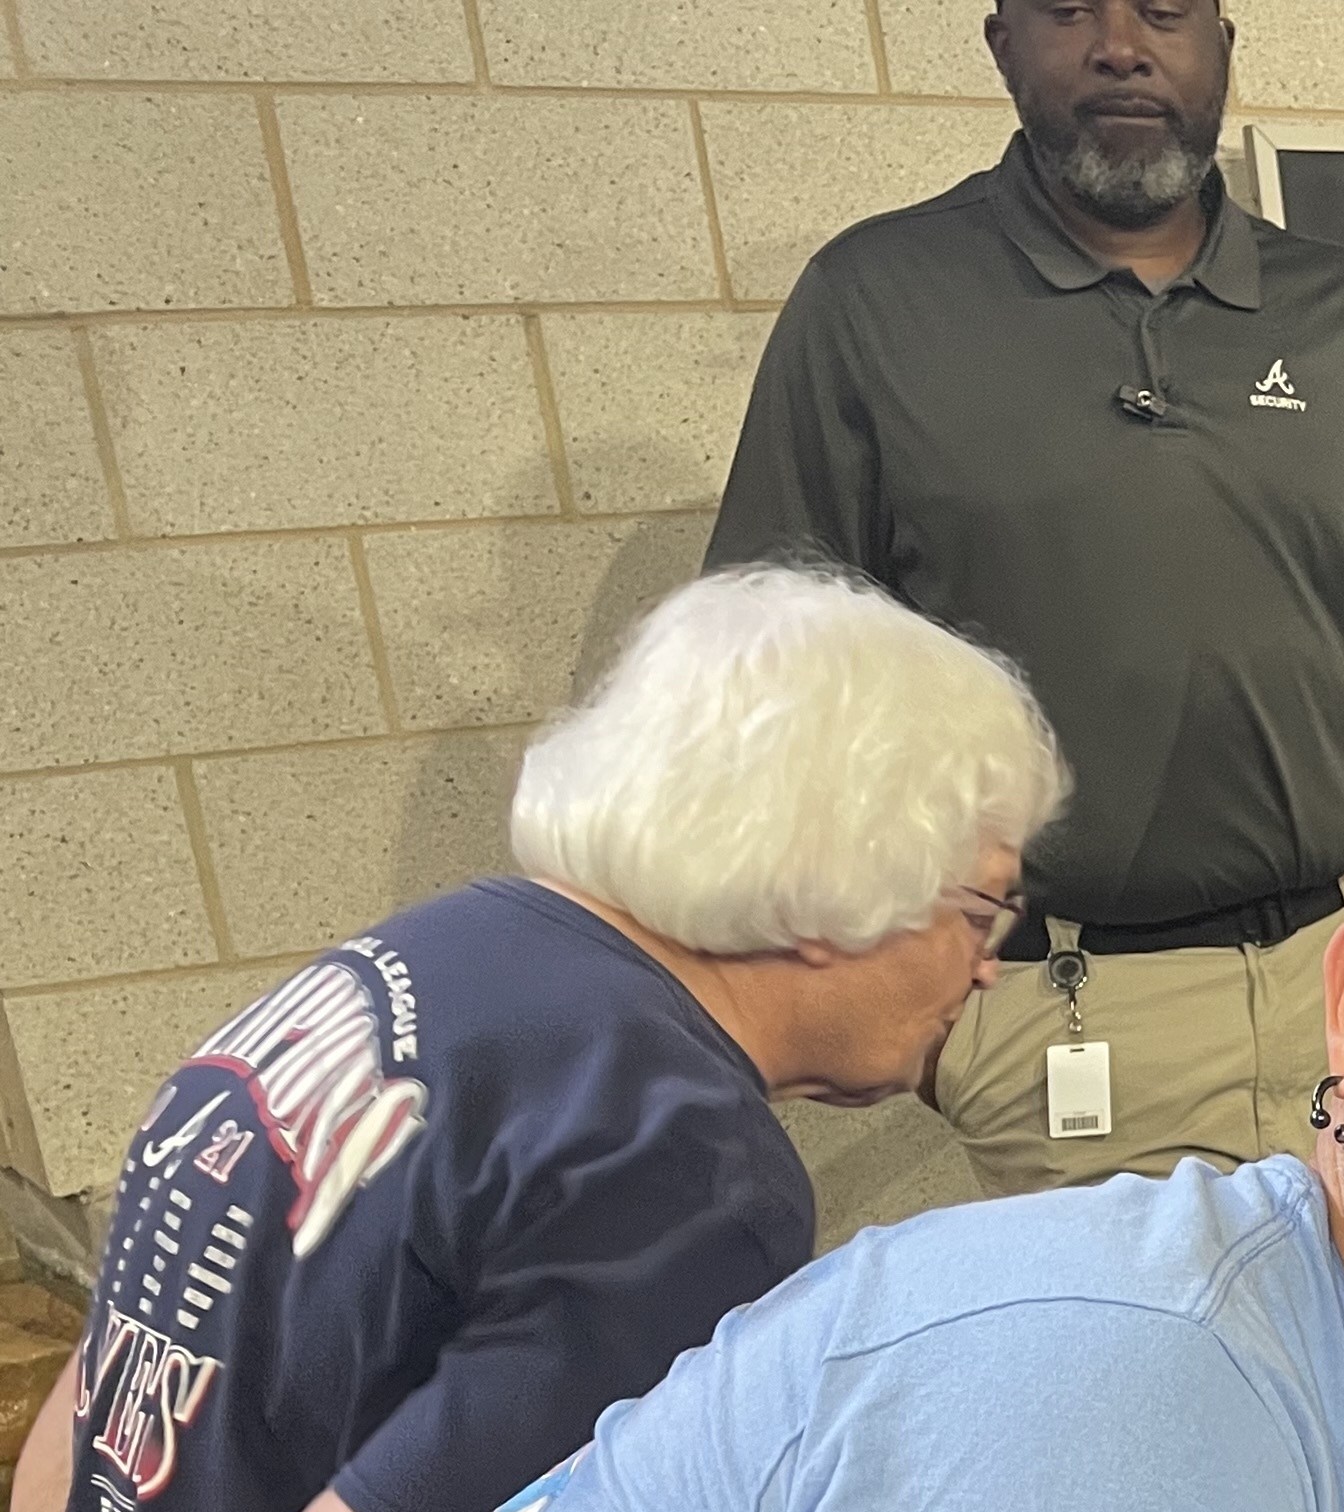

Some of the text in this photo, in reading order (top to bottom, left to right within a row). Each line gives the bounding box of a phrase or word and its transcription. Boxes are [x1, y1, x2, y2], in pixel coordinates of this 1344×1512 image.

[1249, 394, 1306, 412] SECURITY
[374, 950, 419, 1063] LEAGUE
[193, 1119, 254, 1183] 21
